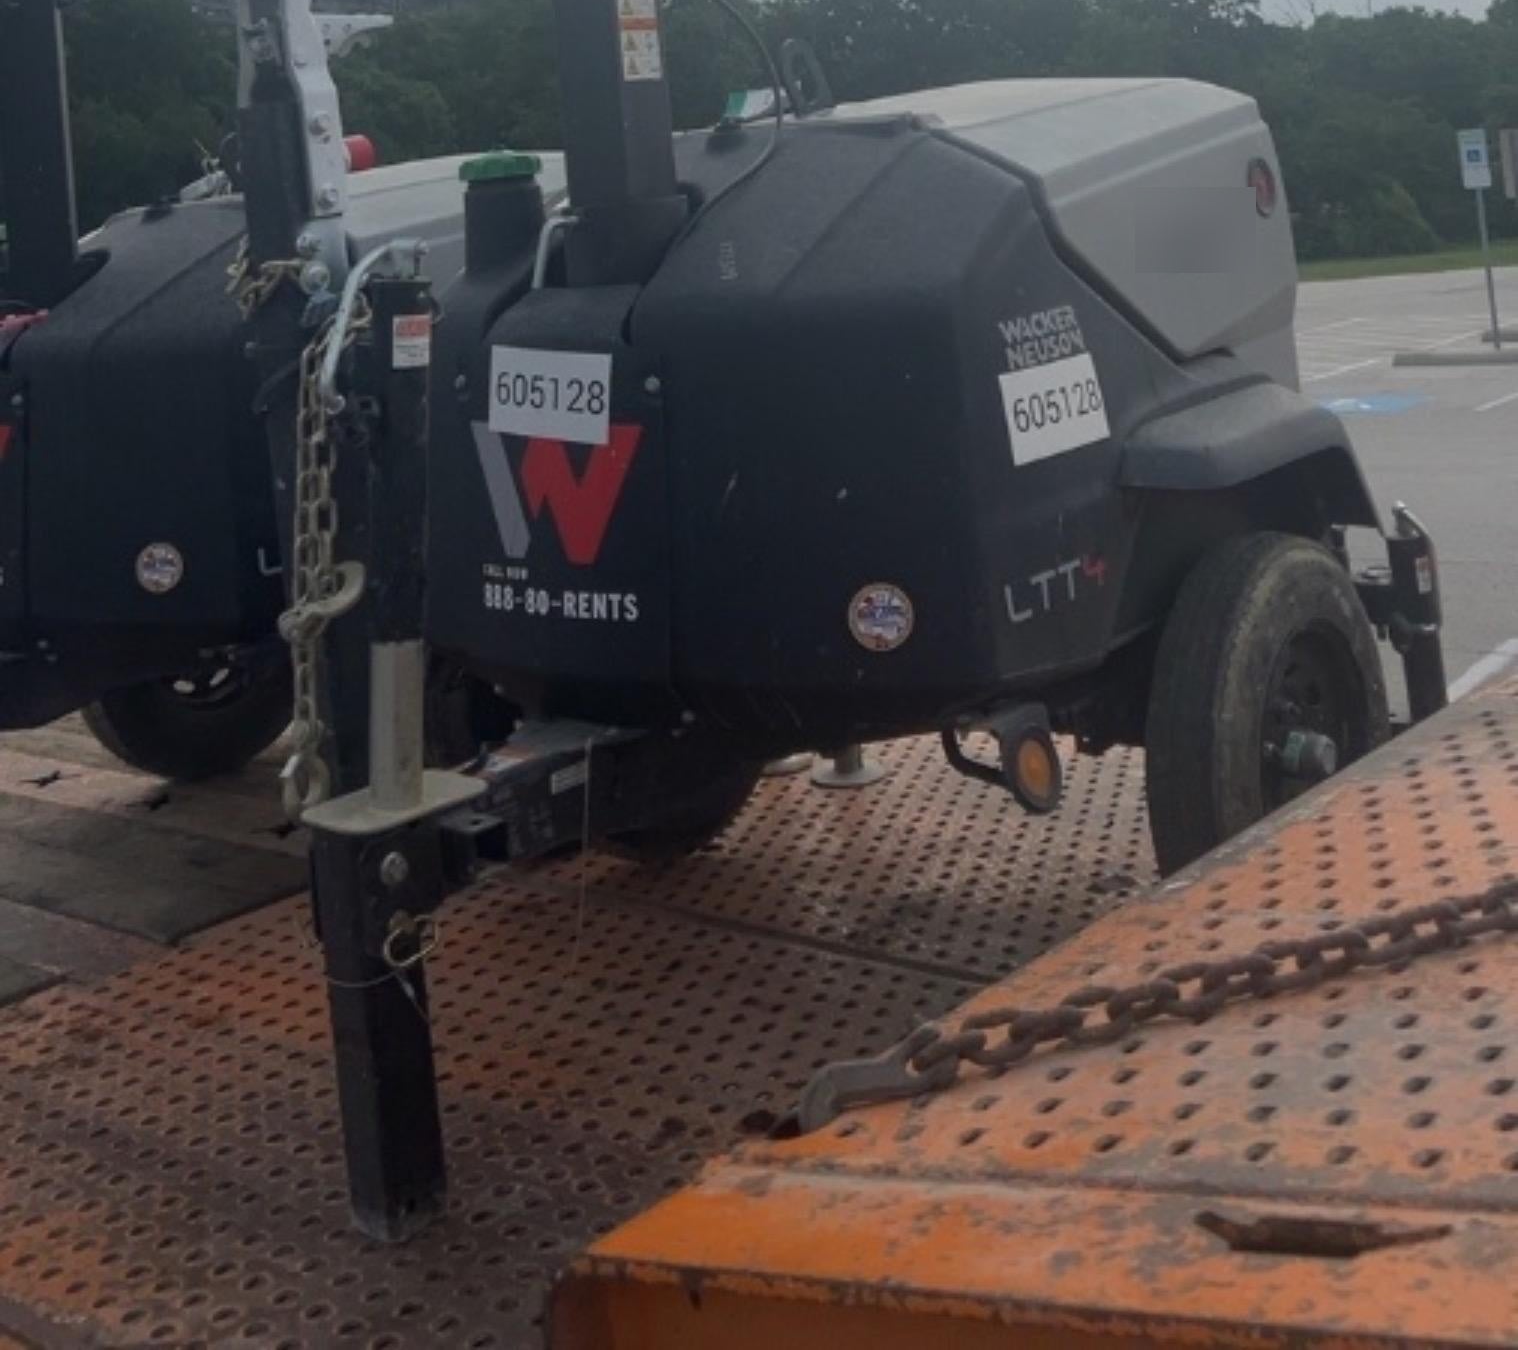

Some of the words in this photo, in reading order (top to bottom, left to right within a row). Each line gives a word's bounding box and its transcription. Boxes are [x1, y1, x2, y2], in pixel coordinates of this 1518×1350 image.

[998, 305, 1077, 341] WACKER
[1006, 327, 1085, 370] NEUSON
[496, 370, 605, 416] 605128
[1013, 377, 1102, 433] 605128
[483, 581, 640, 622] 888-80-RENTS
[1004, 553, 1105, 622] LTT4
